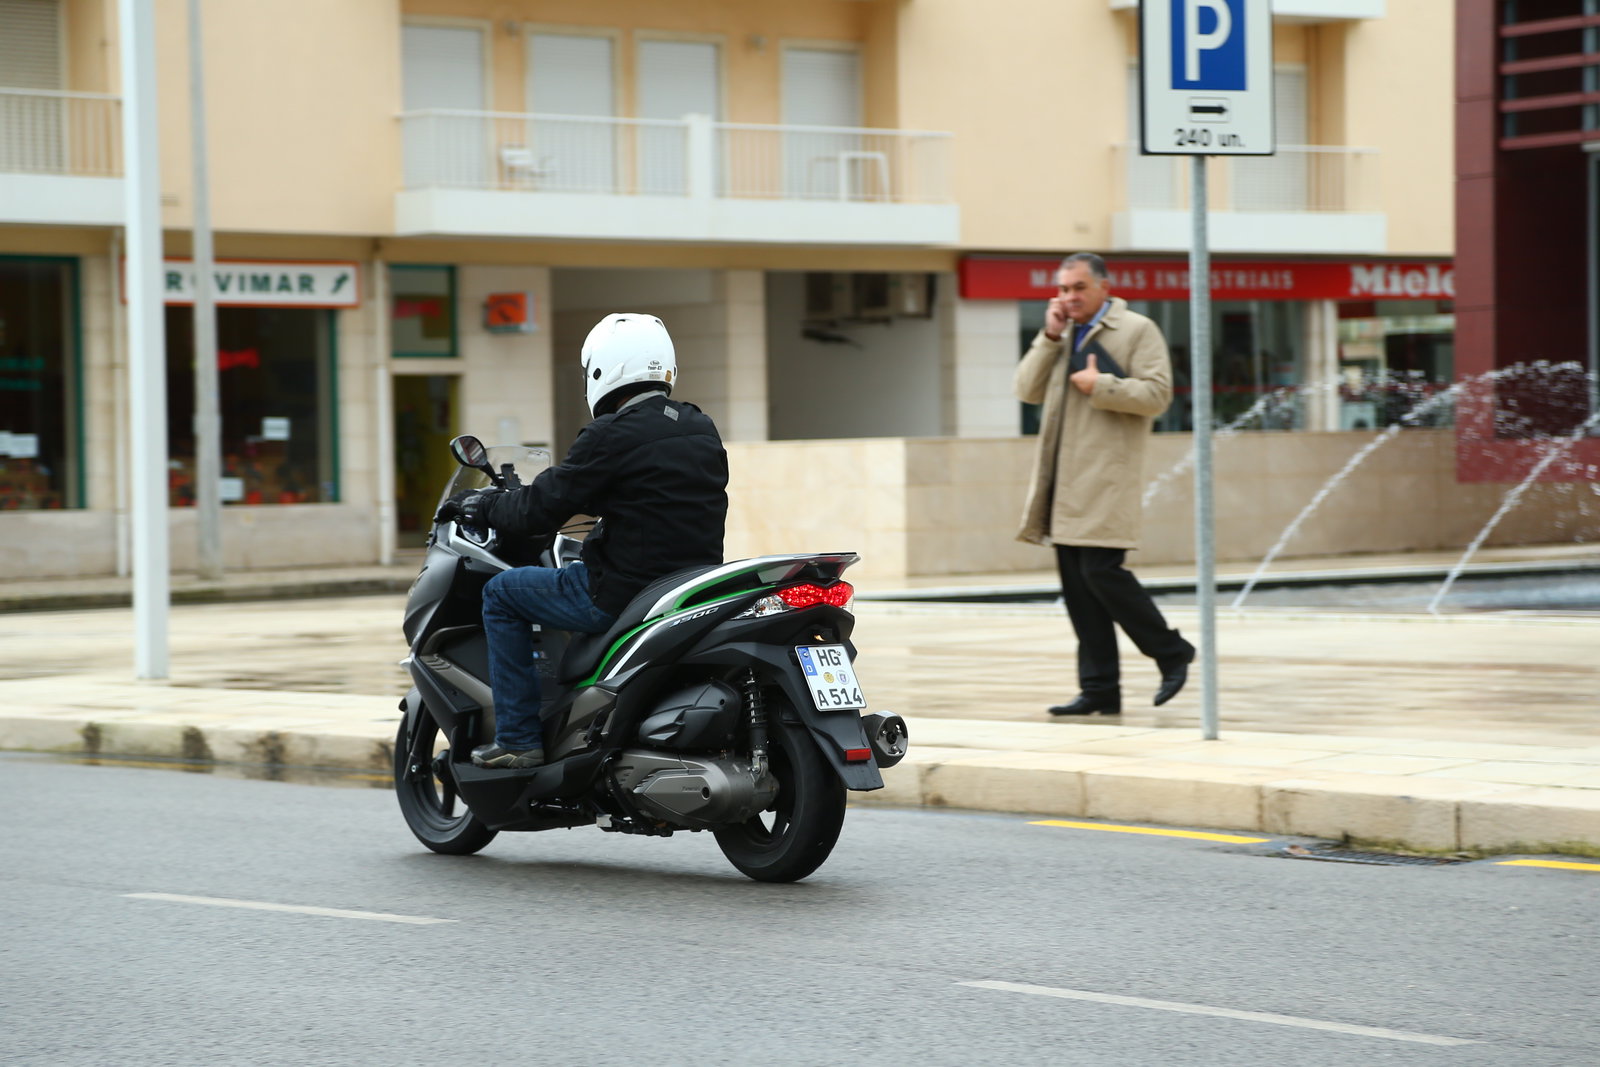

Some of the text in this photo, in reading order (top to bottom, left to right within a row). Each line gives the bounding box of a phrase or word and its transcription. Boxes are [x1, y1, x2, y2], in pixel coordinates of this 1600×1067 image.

[1184, 0, 1232, 81] P
[1174, 128, 1213, 147] 240
[1154, 270, 1294, 290] INDSTRIAIS
[816, 648, 841, 667] HG
[817, 688, 863, 706] A 514
